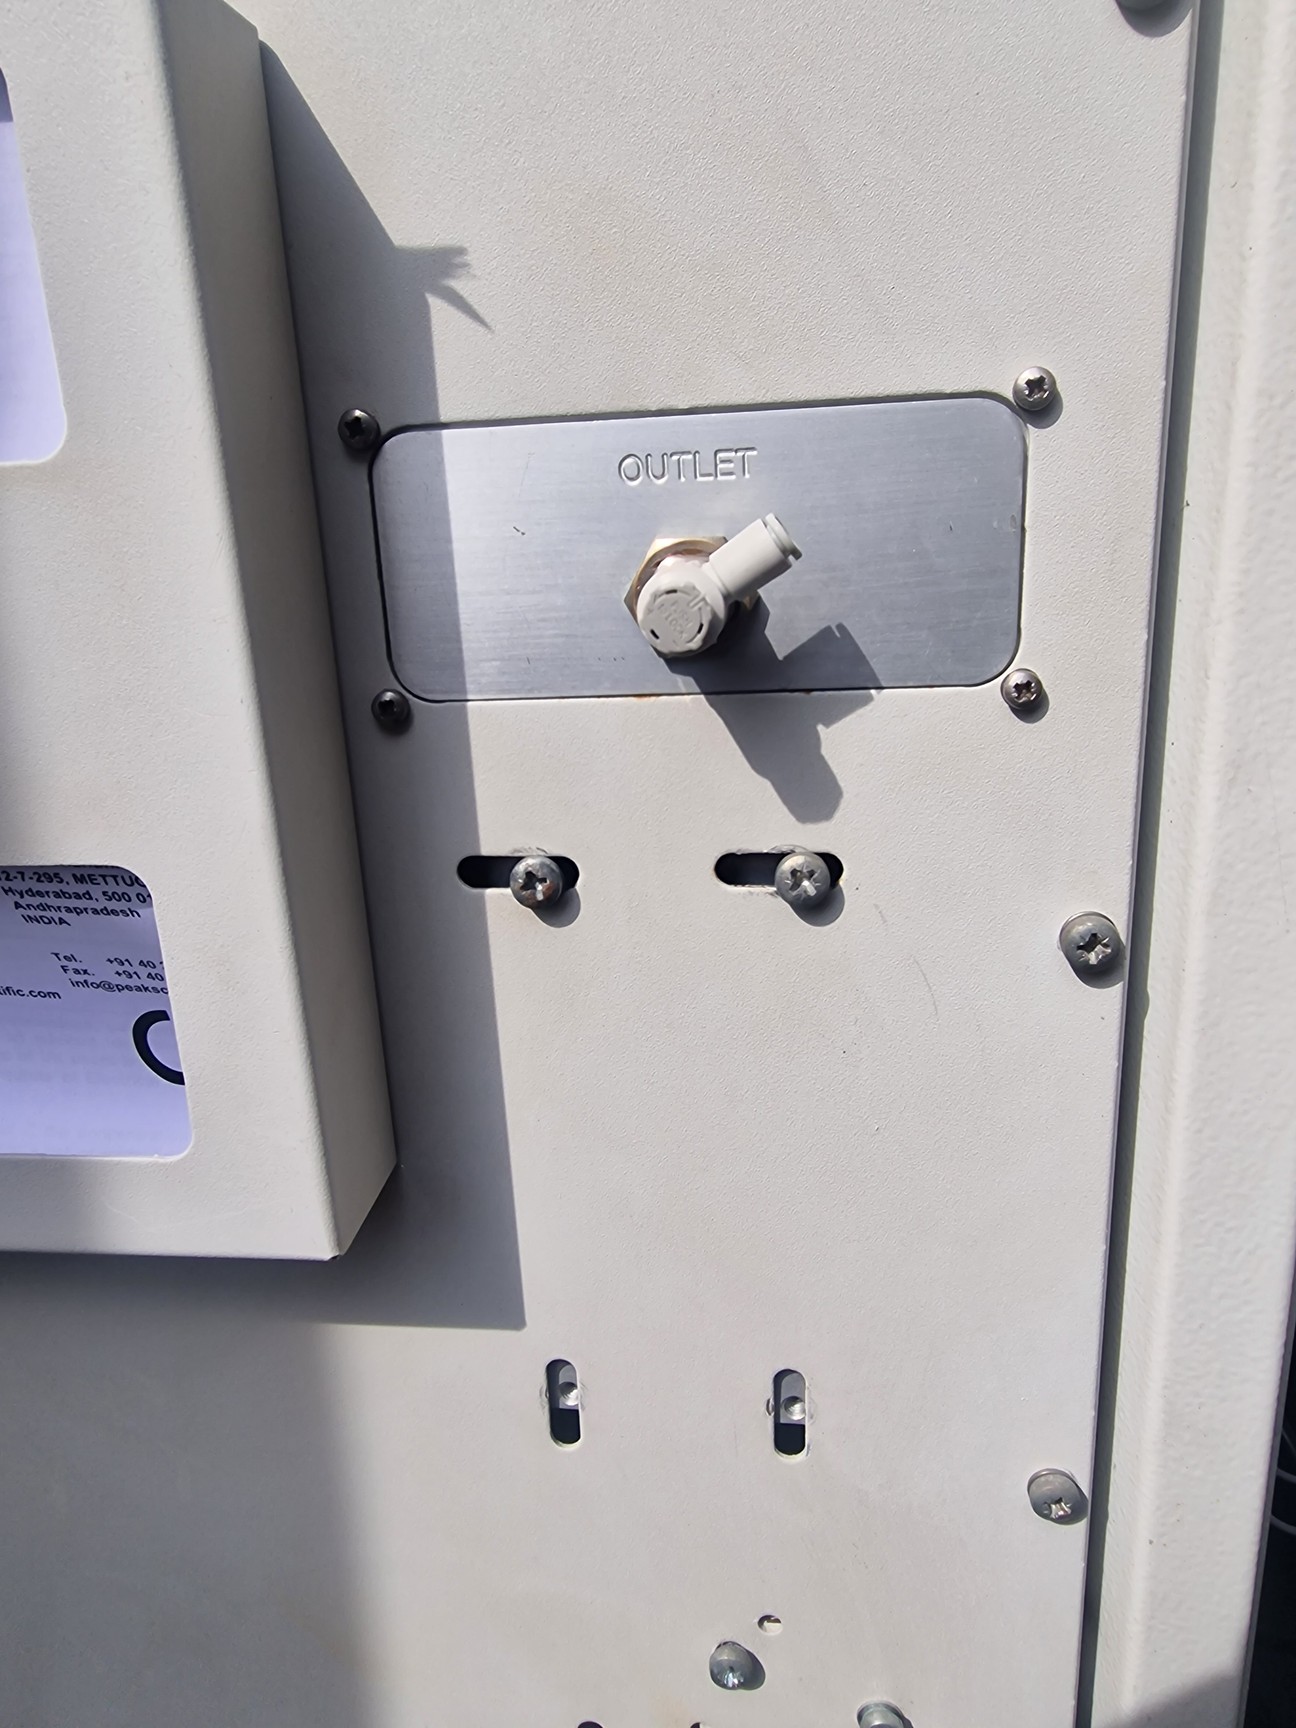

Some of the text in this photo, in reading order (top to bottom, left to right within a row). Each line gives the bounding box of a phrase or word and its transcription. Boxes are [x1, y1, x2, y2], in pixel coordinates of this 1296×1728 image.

[618, 447, 758, 486] OUTLET
[0, 870, 69, 885] 2-7-295,
[1, 886, 99, 902] Hyderabad,
[102, 892, 132, 904] 500
[14, 901, 141, 918] Andhrapradesh
[22, 914, 71, 926] INDIA
[51, 952, 82, 963] Tel.
[106, 957, 133, 967] +91
[138, 959, 157, 969] 40
[60, 965, 164, 982] Fax. +91 40
